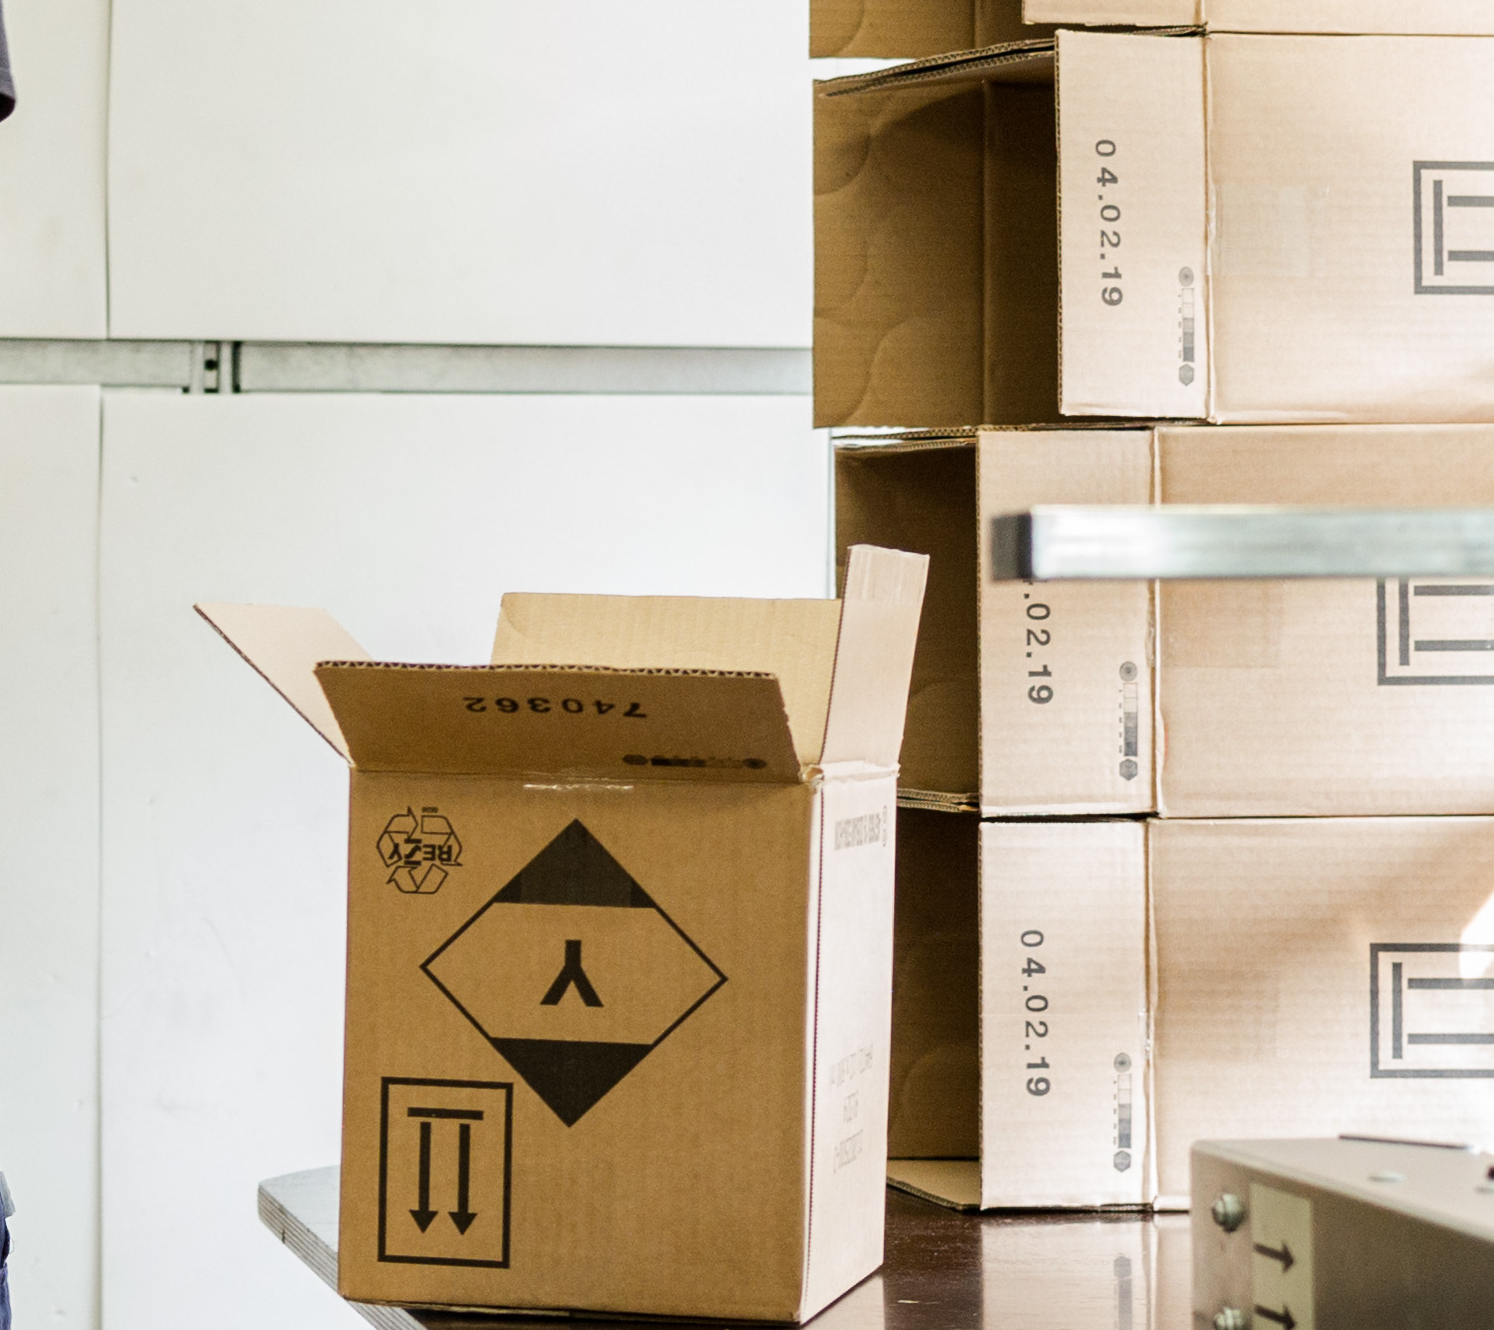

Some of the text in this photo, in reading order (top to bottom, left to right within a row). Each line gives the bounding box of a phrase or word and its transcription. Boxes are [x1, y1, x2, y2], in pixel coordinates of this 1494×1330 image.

[1094, 138, 1124, 308] 04.02.19
[1023, 580, 1054, 705] .02.19
[462, 696, 648, 719] 740362
[539, 938, 604, 1008] Y
[1019, 928, 1050, 1098] 04.02.19
